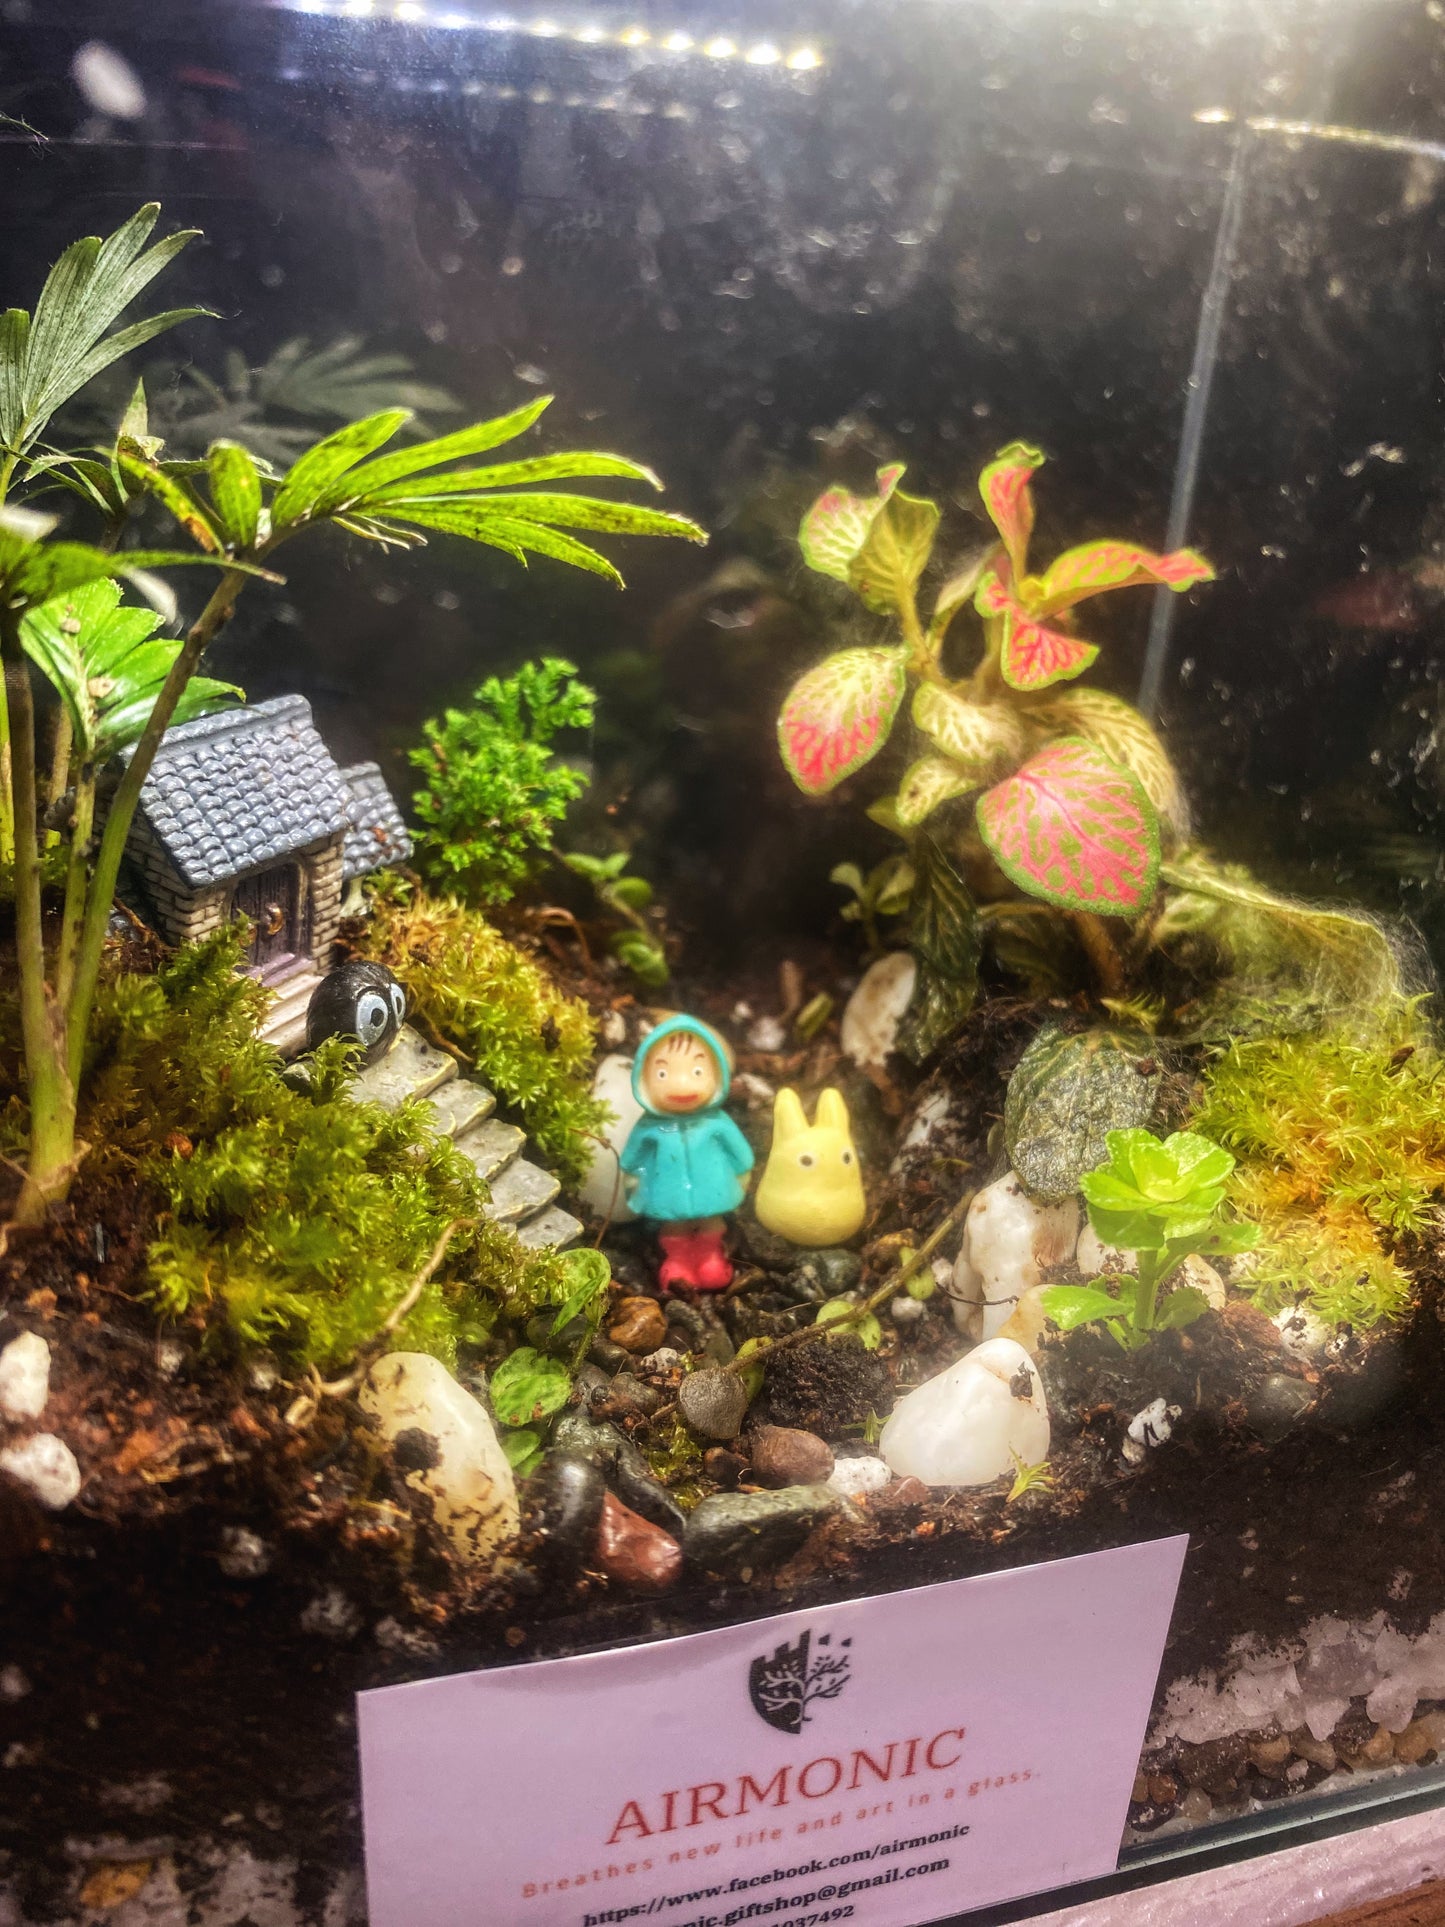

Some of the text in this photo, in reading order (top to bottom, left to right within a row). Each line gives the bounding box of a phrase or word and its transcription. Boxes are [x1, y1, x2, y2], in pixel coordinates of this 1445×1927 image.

[523, 1769, 1041, 1898] Breathes new life and art in a glass.
[605, 1727, 966, 1845] AIRMONIC
[583, 1824, 970, 1927] https://www.facebook.com/airmonic
[673, 1857, 950, 1927] nic.giftshop@gmail.com
[771, 1904, 855, 1927] 037492
